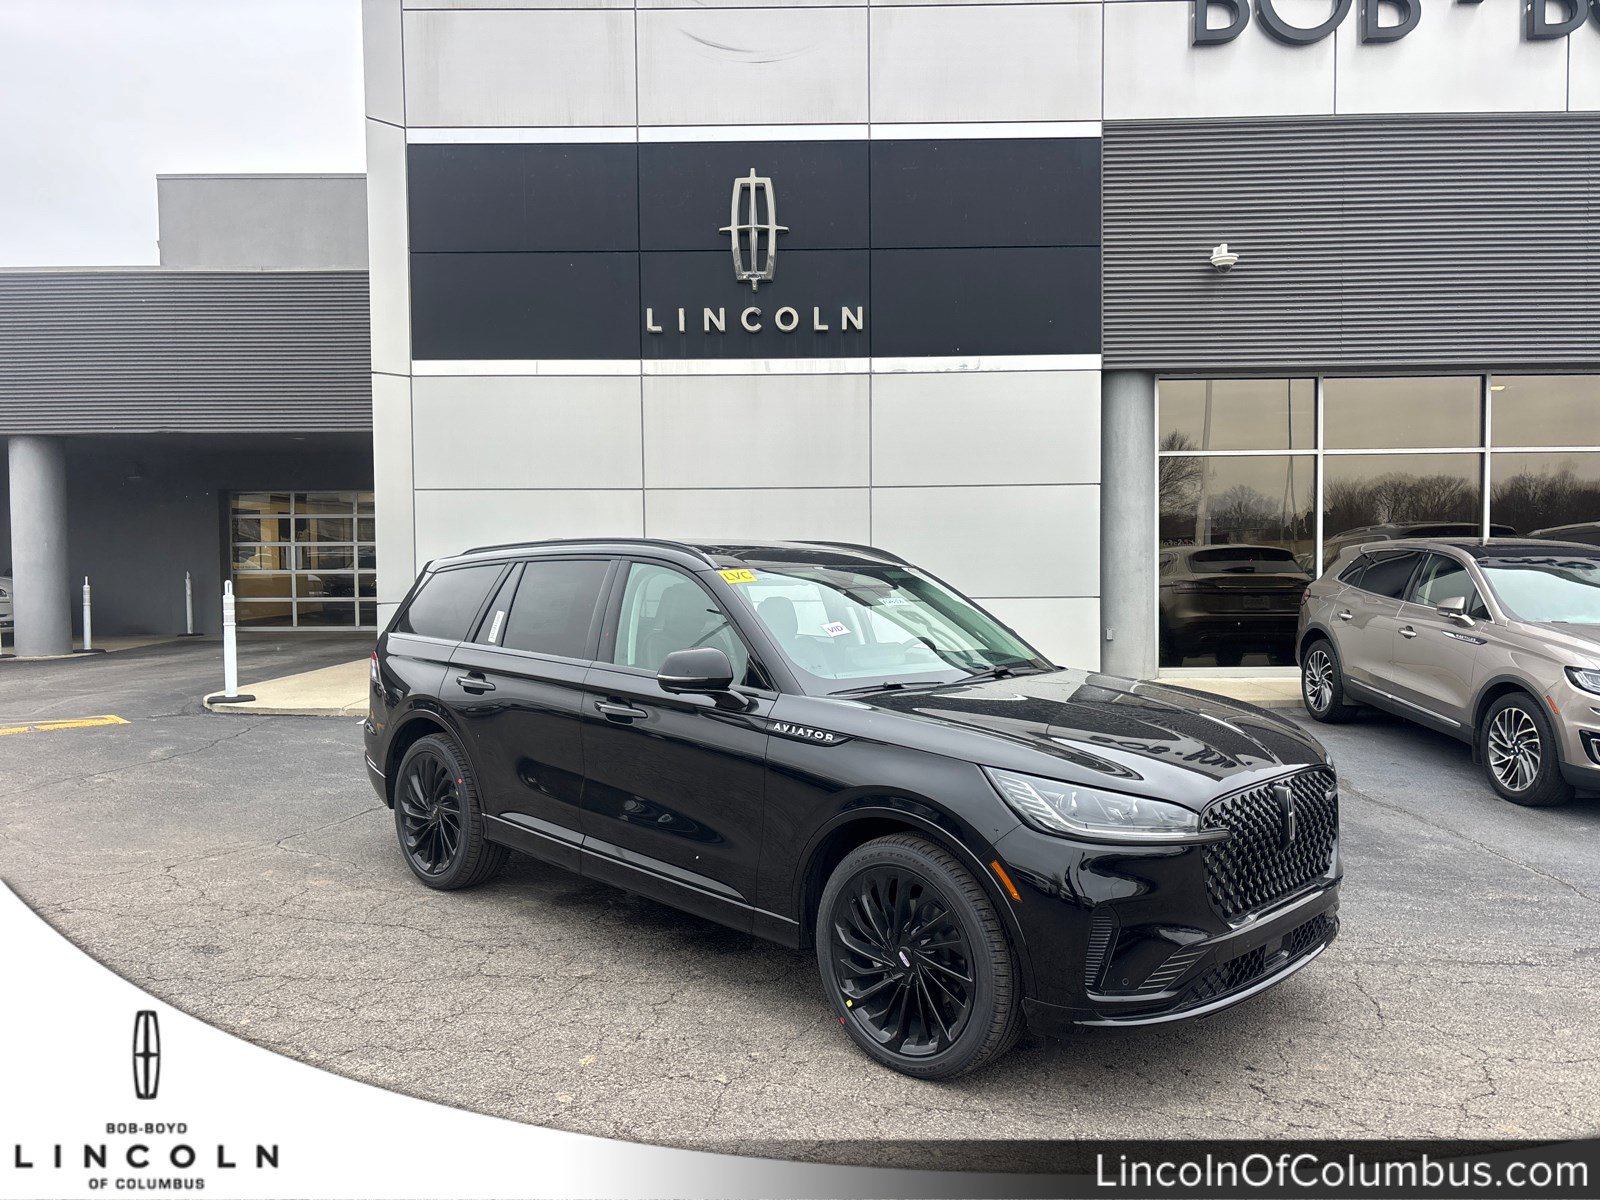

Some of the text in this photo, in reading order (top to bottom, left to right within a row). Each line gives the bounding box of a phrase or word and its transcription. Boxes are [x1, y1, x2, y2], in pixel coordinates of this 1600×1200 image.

[646, 306, 864, 333] LINCOLN
[723, 571, 753, 581] LVC
[773, 722, 834, 742] AVIATOR
